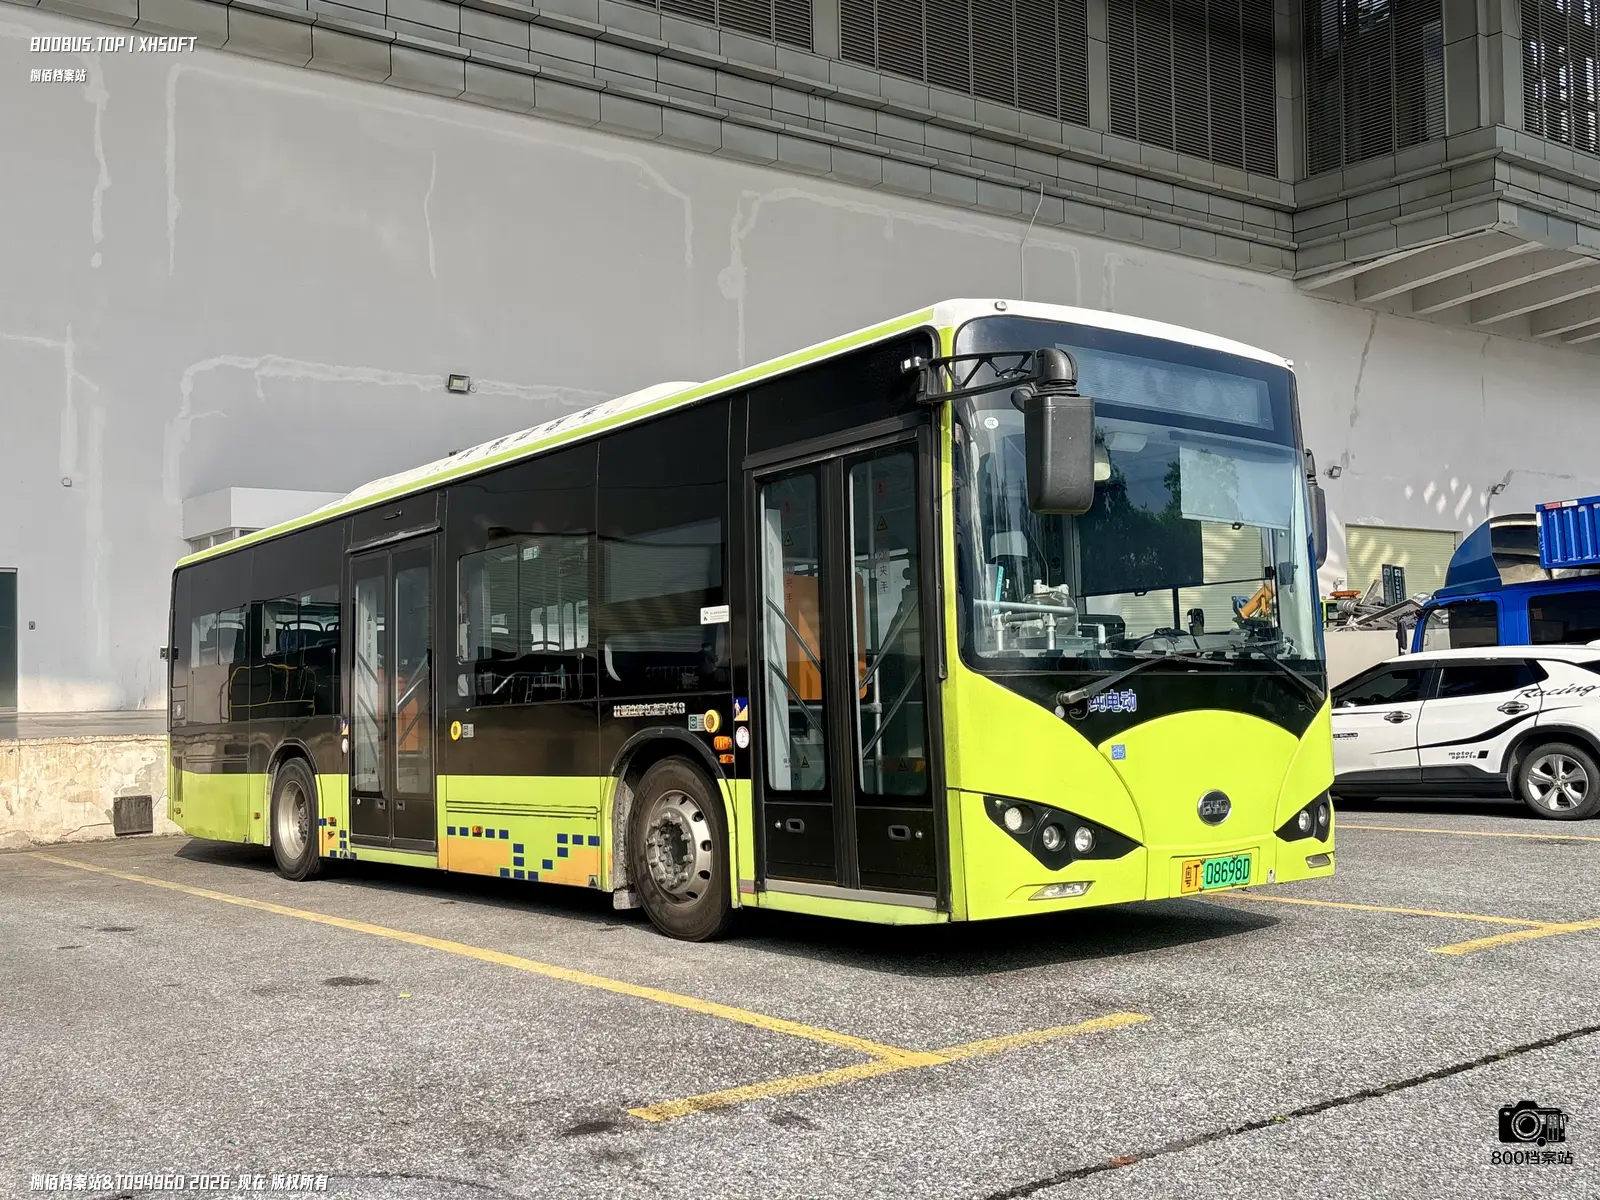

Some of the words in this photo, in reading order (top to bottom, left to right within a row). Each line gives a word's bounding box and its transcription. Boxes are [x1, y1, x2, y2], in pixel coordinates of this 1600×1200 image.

[1513, 683, 1599, 700] Racing
[1090, 689, 1137, 712] 纯电动
[1202, 800, 1228, 815] BYD
